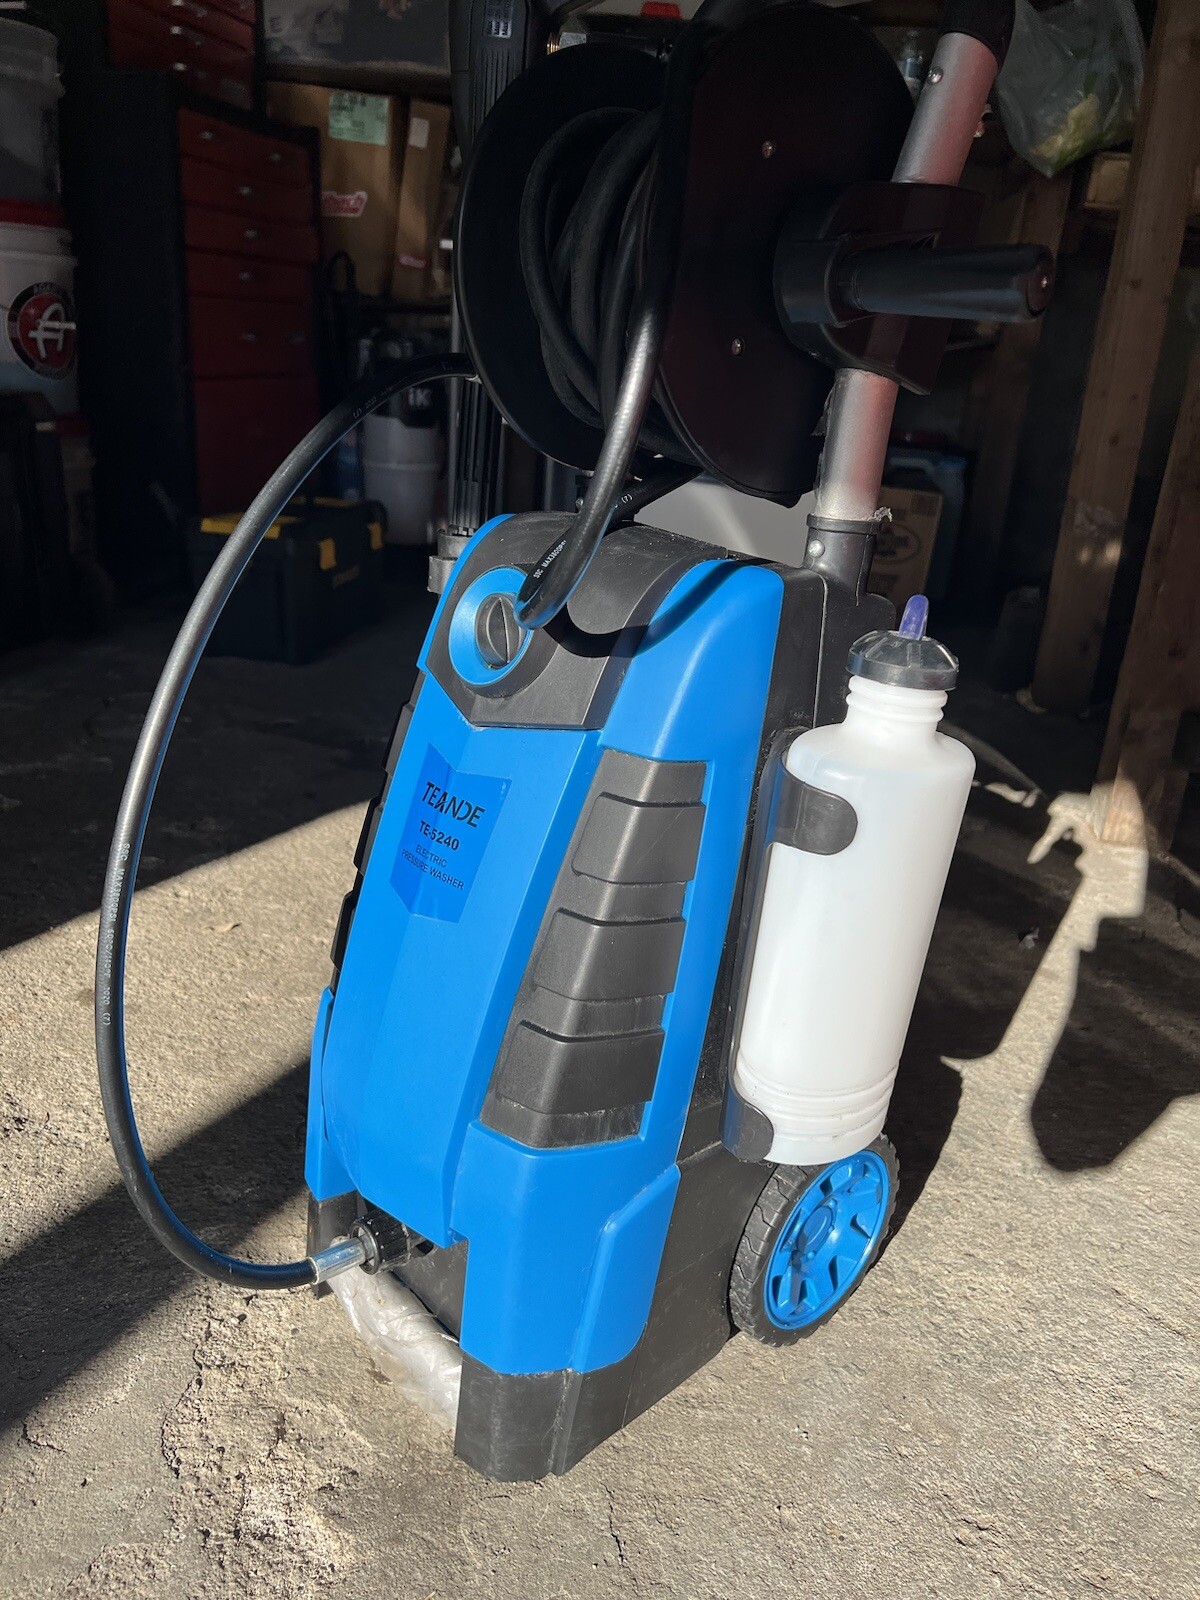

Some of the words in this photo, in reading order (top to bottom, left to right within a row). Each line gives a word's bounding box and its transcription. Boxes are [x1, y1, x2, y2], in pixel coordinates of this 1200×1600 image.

[421, 781, 486, 828] TEANDE
[419, 820, 460, 851] TE-5240
[120, 843, 130, 861] SSC
[415, 845, 448, 869] ELECTRIC
[401, 849, 429, 873] PRESSURE
[429, 867, 464, 890] WASHER
